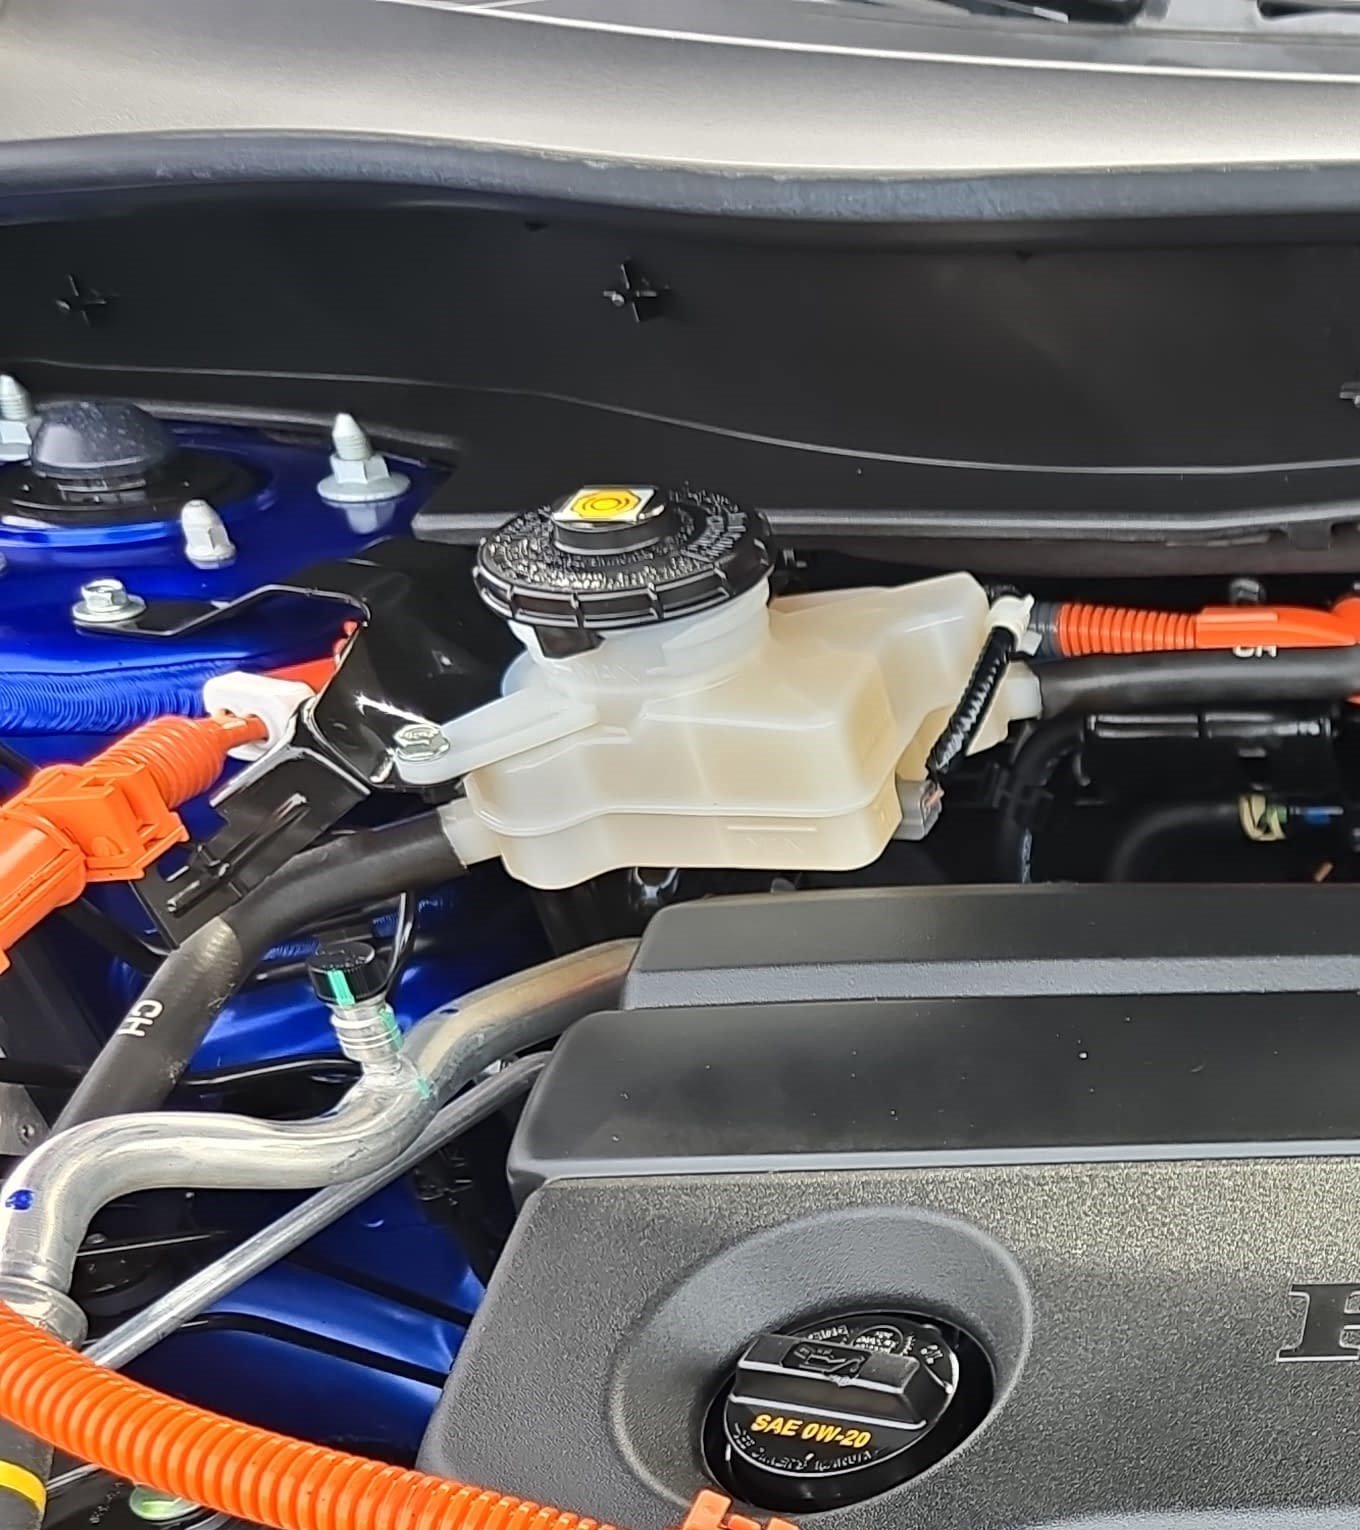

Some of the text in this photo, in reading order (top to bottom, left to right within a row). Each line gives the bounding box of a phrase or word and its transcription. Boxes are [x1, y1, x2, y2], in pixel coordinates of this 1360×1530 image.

[118, 1000, 163, 1036] CH
[751, 1414, 872, 1448] SAE 0W-20
